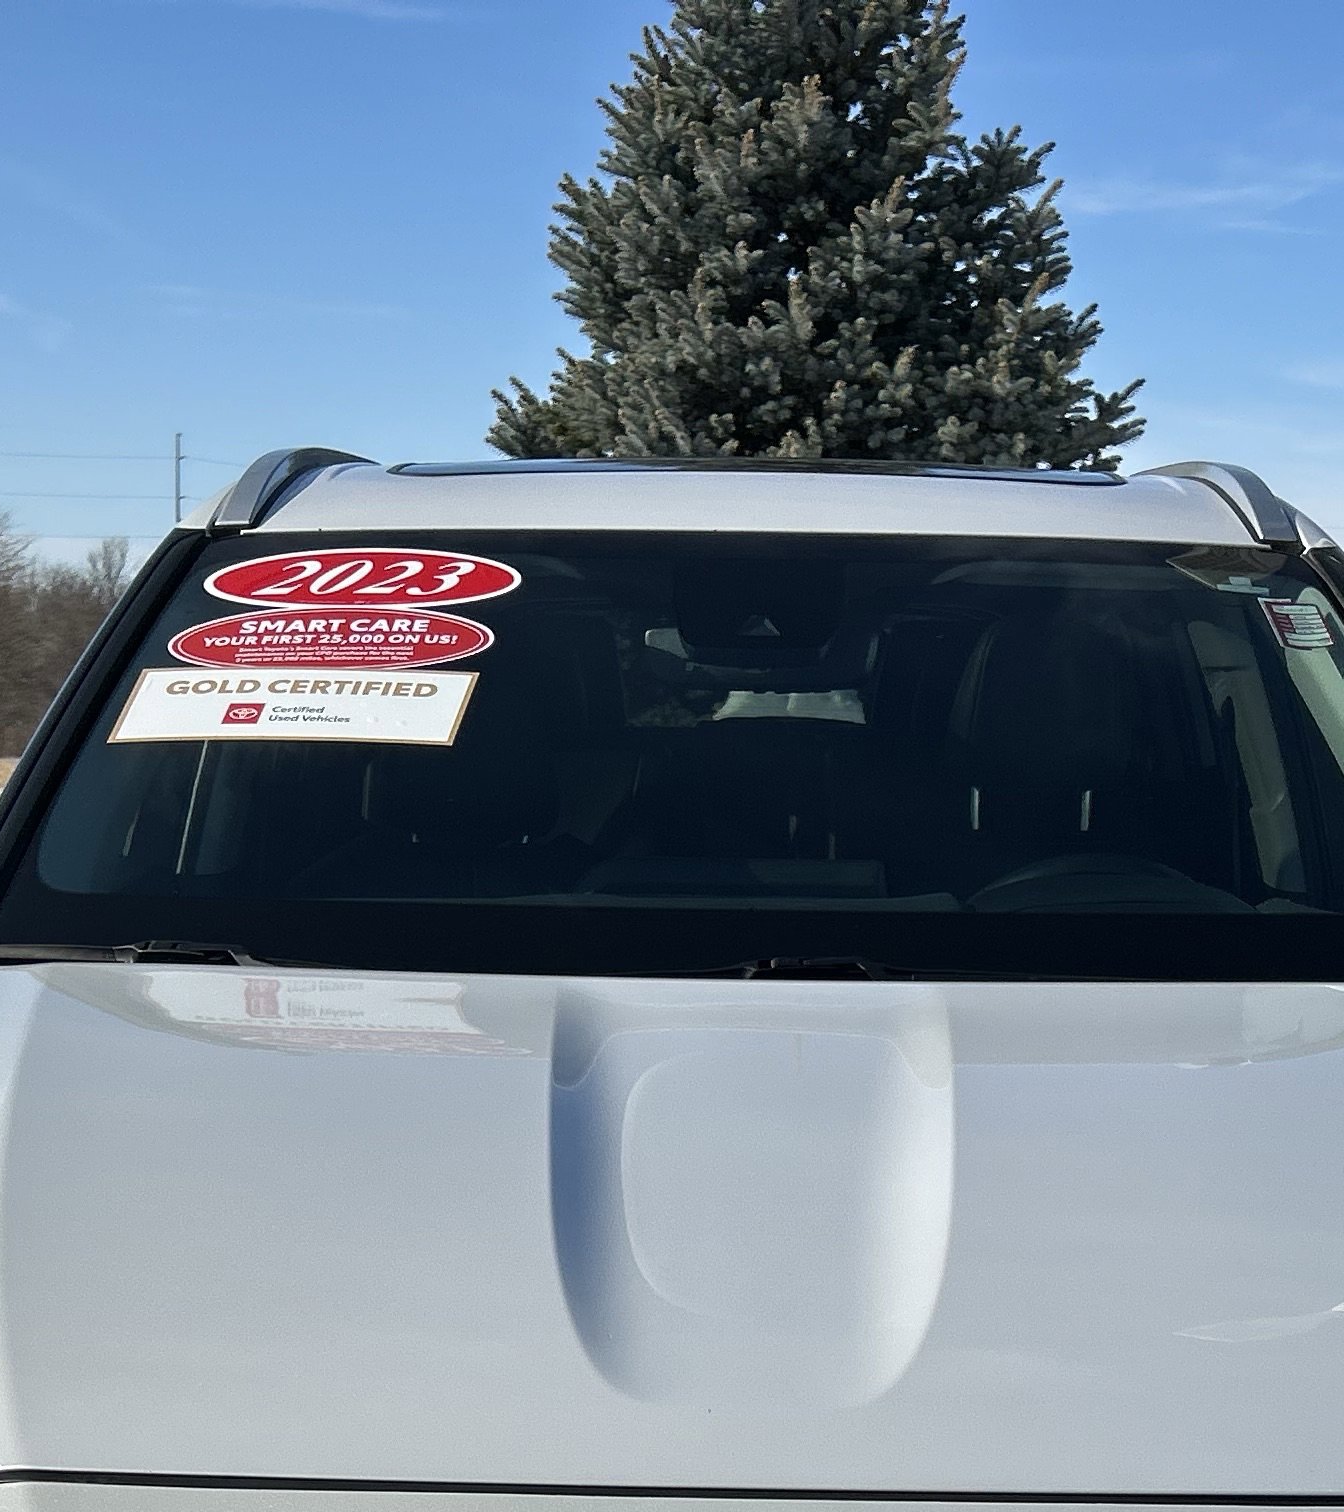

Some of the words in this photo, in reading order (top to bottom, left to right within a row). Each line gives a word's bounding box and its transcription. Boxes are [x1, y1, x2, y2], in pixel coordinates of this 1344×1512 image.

[250, 559, 477, 596] 2023
[239, 619, 347, 634] SMART
[349, 618, 431, 632] CARE
[203, 635, 258, 647] YOUR
[260, 634, 317, 645] FIRST
[317, 633, 385, 645] 25,000
[387, 634, 421, 645] ON
[424, 634, 459, 645] US!
[165, 679, 261, 695] GOLD
[267, 679, 438, 697] CERTIFIED
[272, 706, 325, 714] Certified
[268, 714, 300, 723] Used
[302, 714, 351, 723] Vehicles
